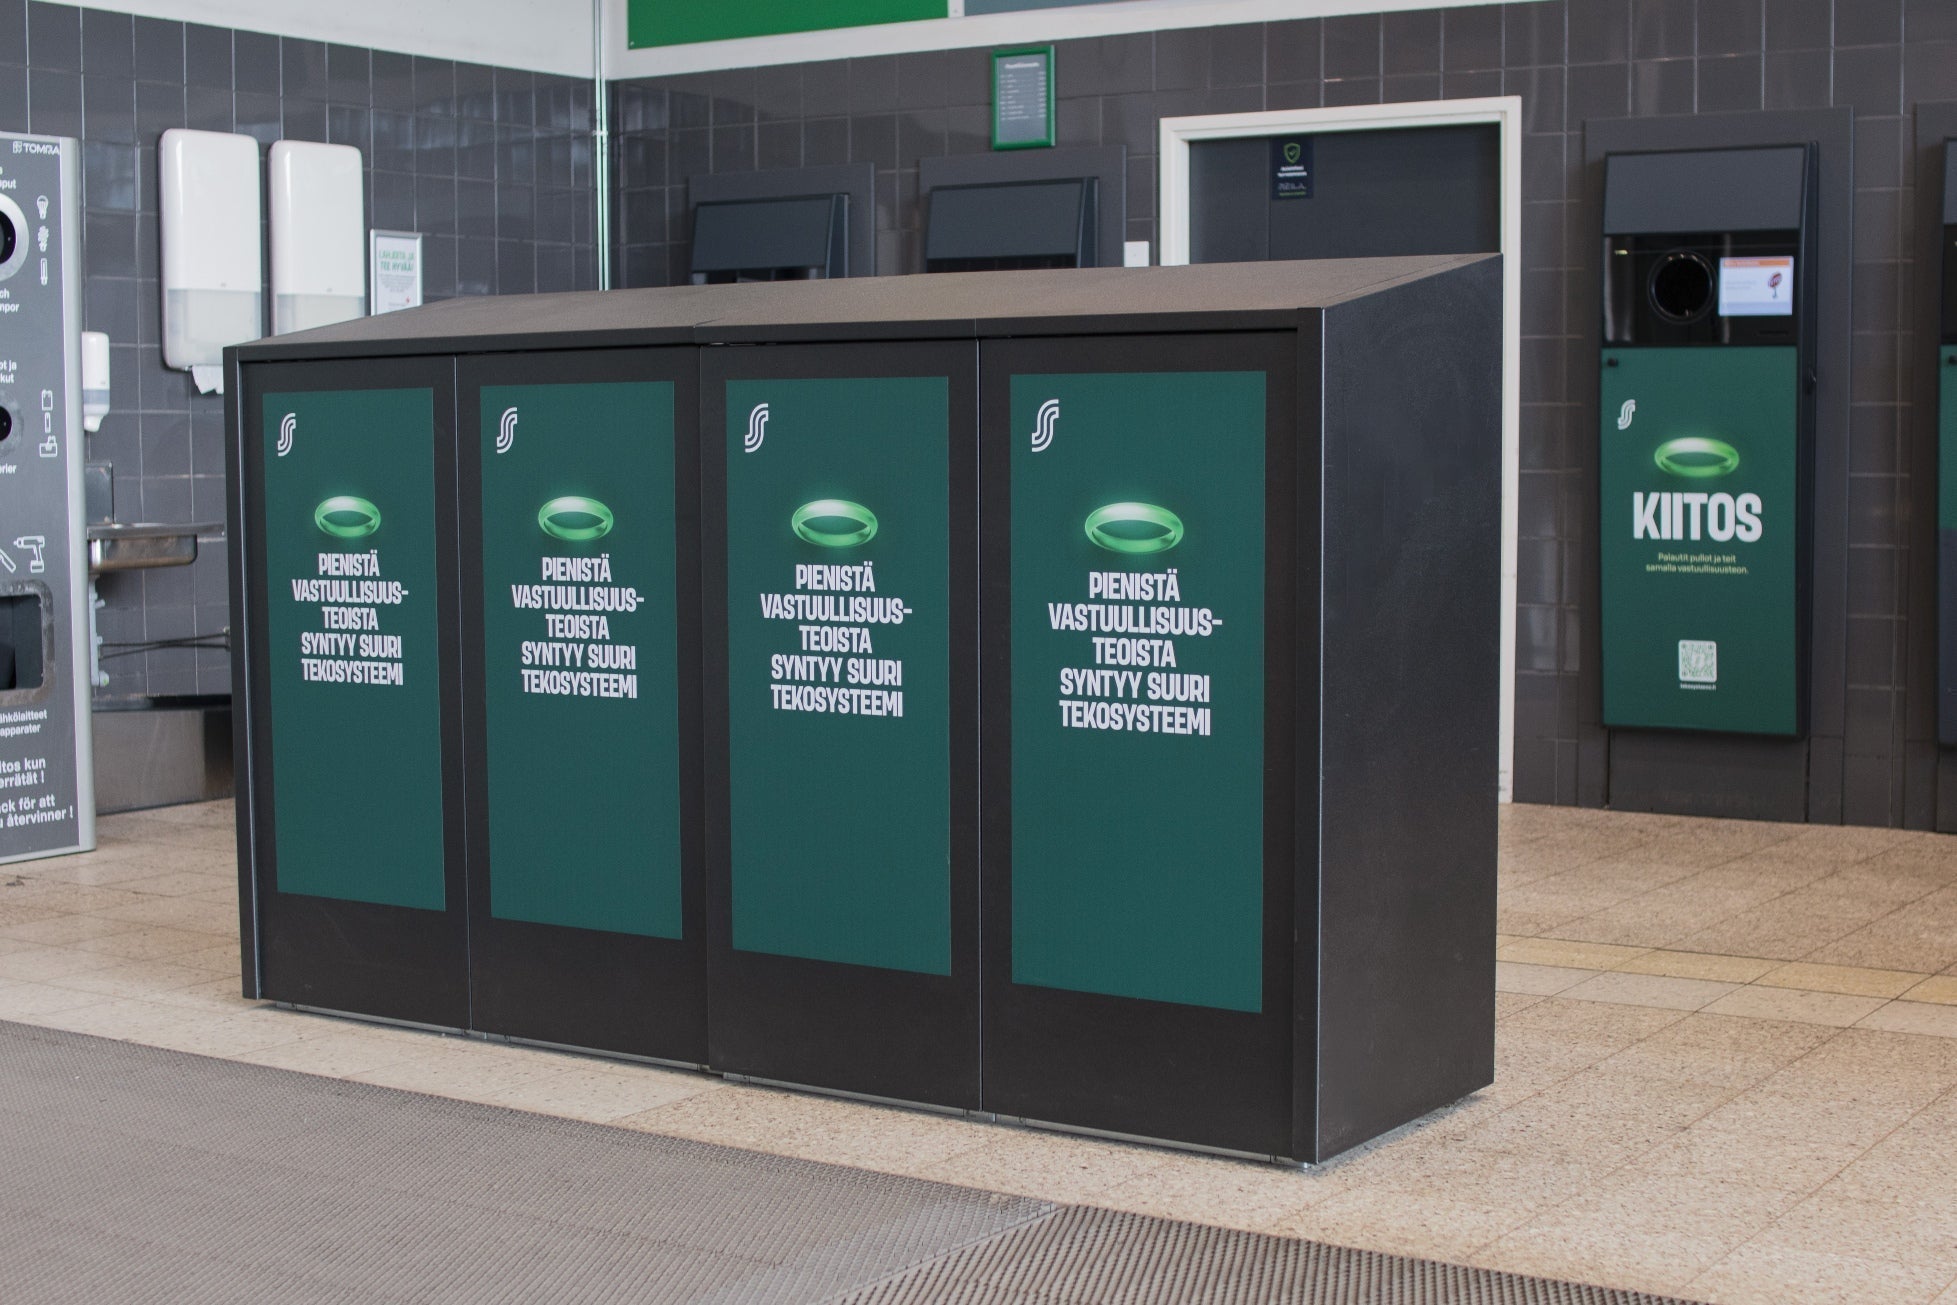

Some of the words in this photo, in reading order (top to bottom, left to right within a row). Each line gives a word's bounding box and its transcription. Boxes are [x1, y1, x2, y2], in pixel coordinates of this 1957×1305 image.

[22, 142, 60, 156] TOMRA
[1633, 492, 1763, 542] KIITOS
[318, 549, 380, 576] PIENISTÄ
[542, 553, 612, 582] PIENISTÄ
[1646, 563, 1677, 573] samalla
[1658, 552, 1689, 563] Palautit
[1690, 553, 1712, 564] pullot
[1714, 554, 1722, 564] ja
[1722, 555, 1736, 564] teit
[796, 561, 875, 592] PIENISTÄ
[1089, 568, 1180, 602] PIENISTÄ
[292, 579, 409, 604] VASTUULLISUUS-
[512, 584, 644, 612] VASTUULLISUUS-
[322, 606, 379, 630] TEOISTA
[760, 593, 913, 624] VASTUULLISUUS-
[1048, 602, 1223, 636] VASTUULLISUUS-
[545, 614, 610, 640] TEOISTA
[799, 625, 873, 653] TEOISTA
[301, 632, 356, 656] SYNTYY
[360, 634, 402, 658] SUURI
[522, 641, 584, 667] SYNTYY
[588, 644, 636, 670] SUURI
[1092, 636, 1176, 667] TEOISTA
[301, 658, 403, 686] TEKOSYSTEEMI
[521, 669, 638, 699] TEKOSYSTEEMI
[771, 654, 842, 682] SYNTYY
[848, 657, 902, 686] SUURI
[1060, 668, 1143, 698] SYNTYY
[1147, 672, 1210, 703] SUURI
[771, 684, 903, 717] TEKOSYSTEEMI
[1059, 699, 1210, 736] TEKOSYSTEEMI
[24, 757, 46, 771] kun
[18, 796, 36, 811] för
[39, 793, 56, 809] att
[6, 808, 67, 828] återvinner
